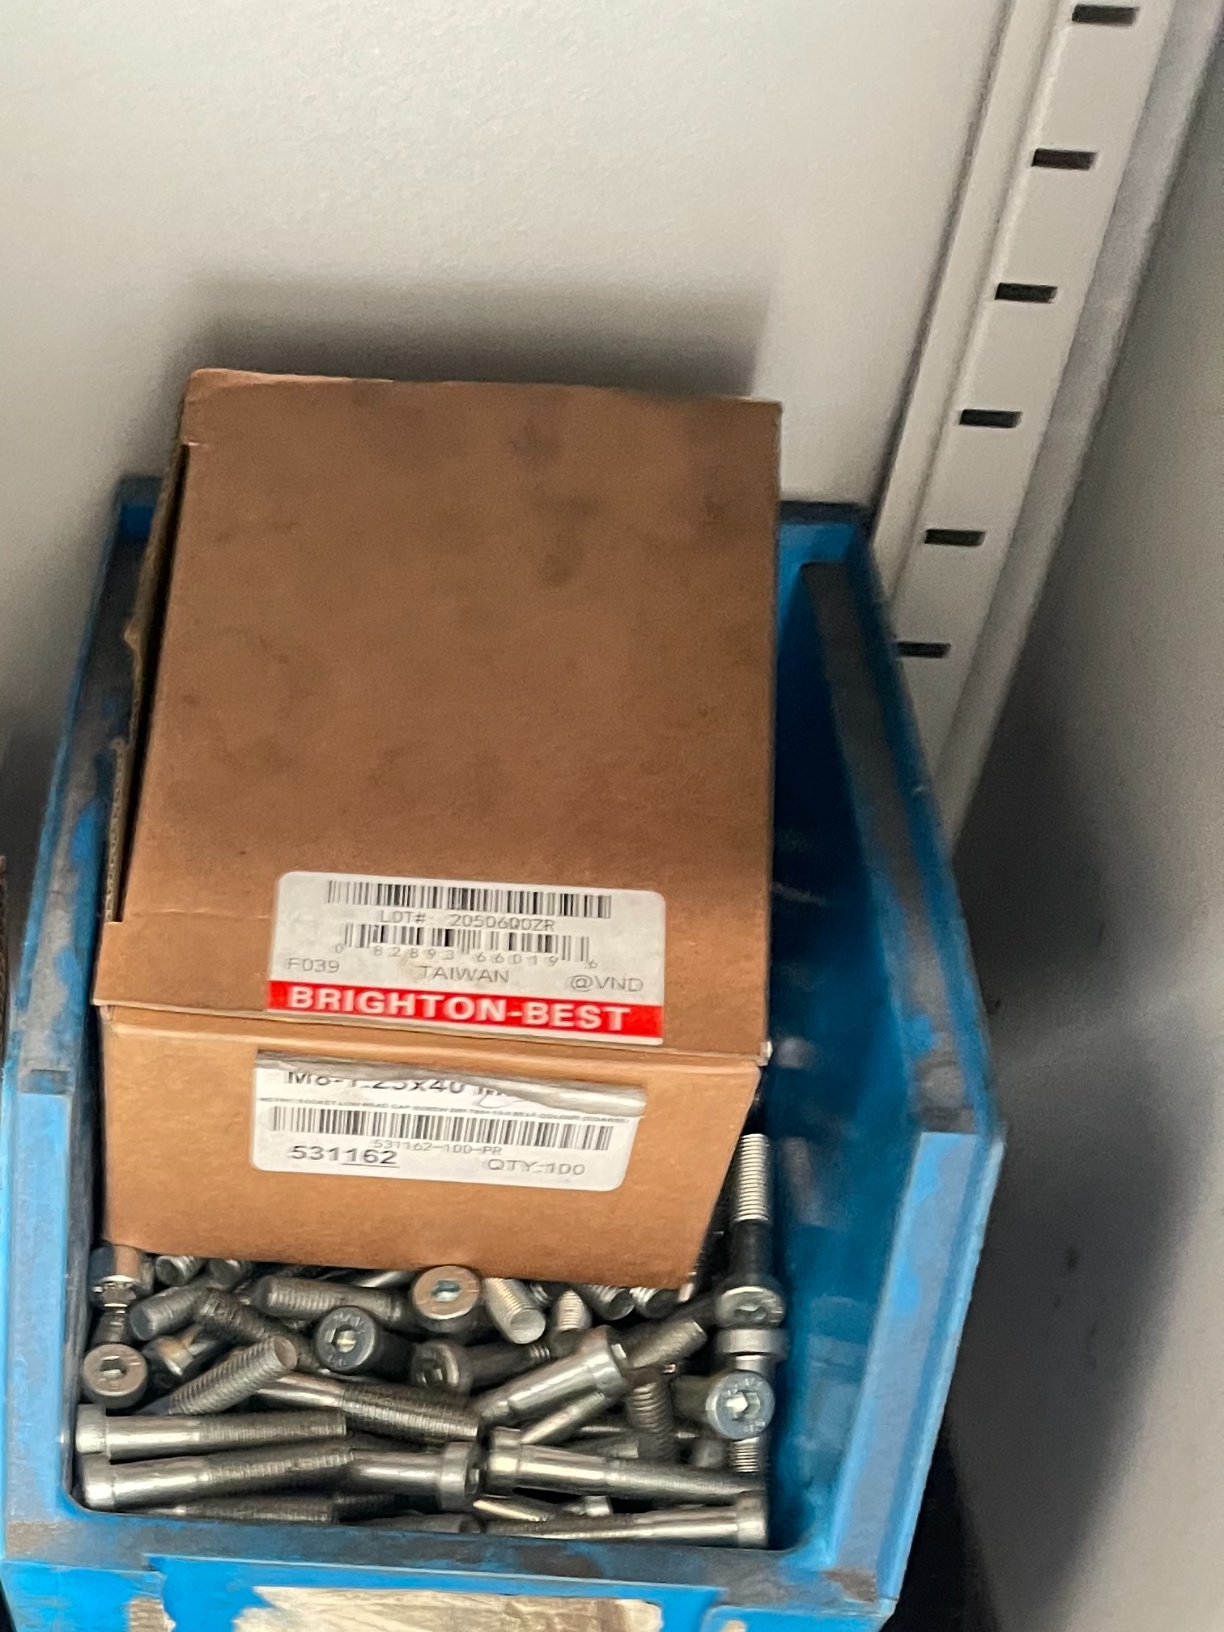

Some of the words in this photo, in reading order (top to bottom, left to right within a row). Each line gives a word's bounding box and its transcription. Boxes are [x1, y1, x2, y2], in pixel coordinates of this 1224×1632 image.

[287, 956, 341, 974] F039
[417, 964, 510, 984] TAIWAN
[569, 974, 644, 993] @VND
[288, 984, 631, 1032] BRIGHTON-BEST
[289, 1144, 398, 1166] 531162
